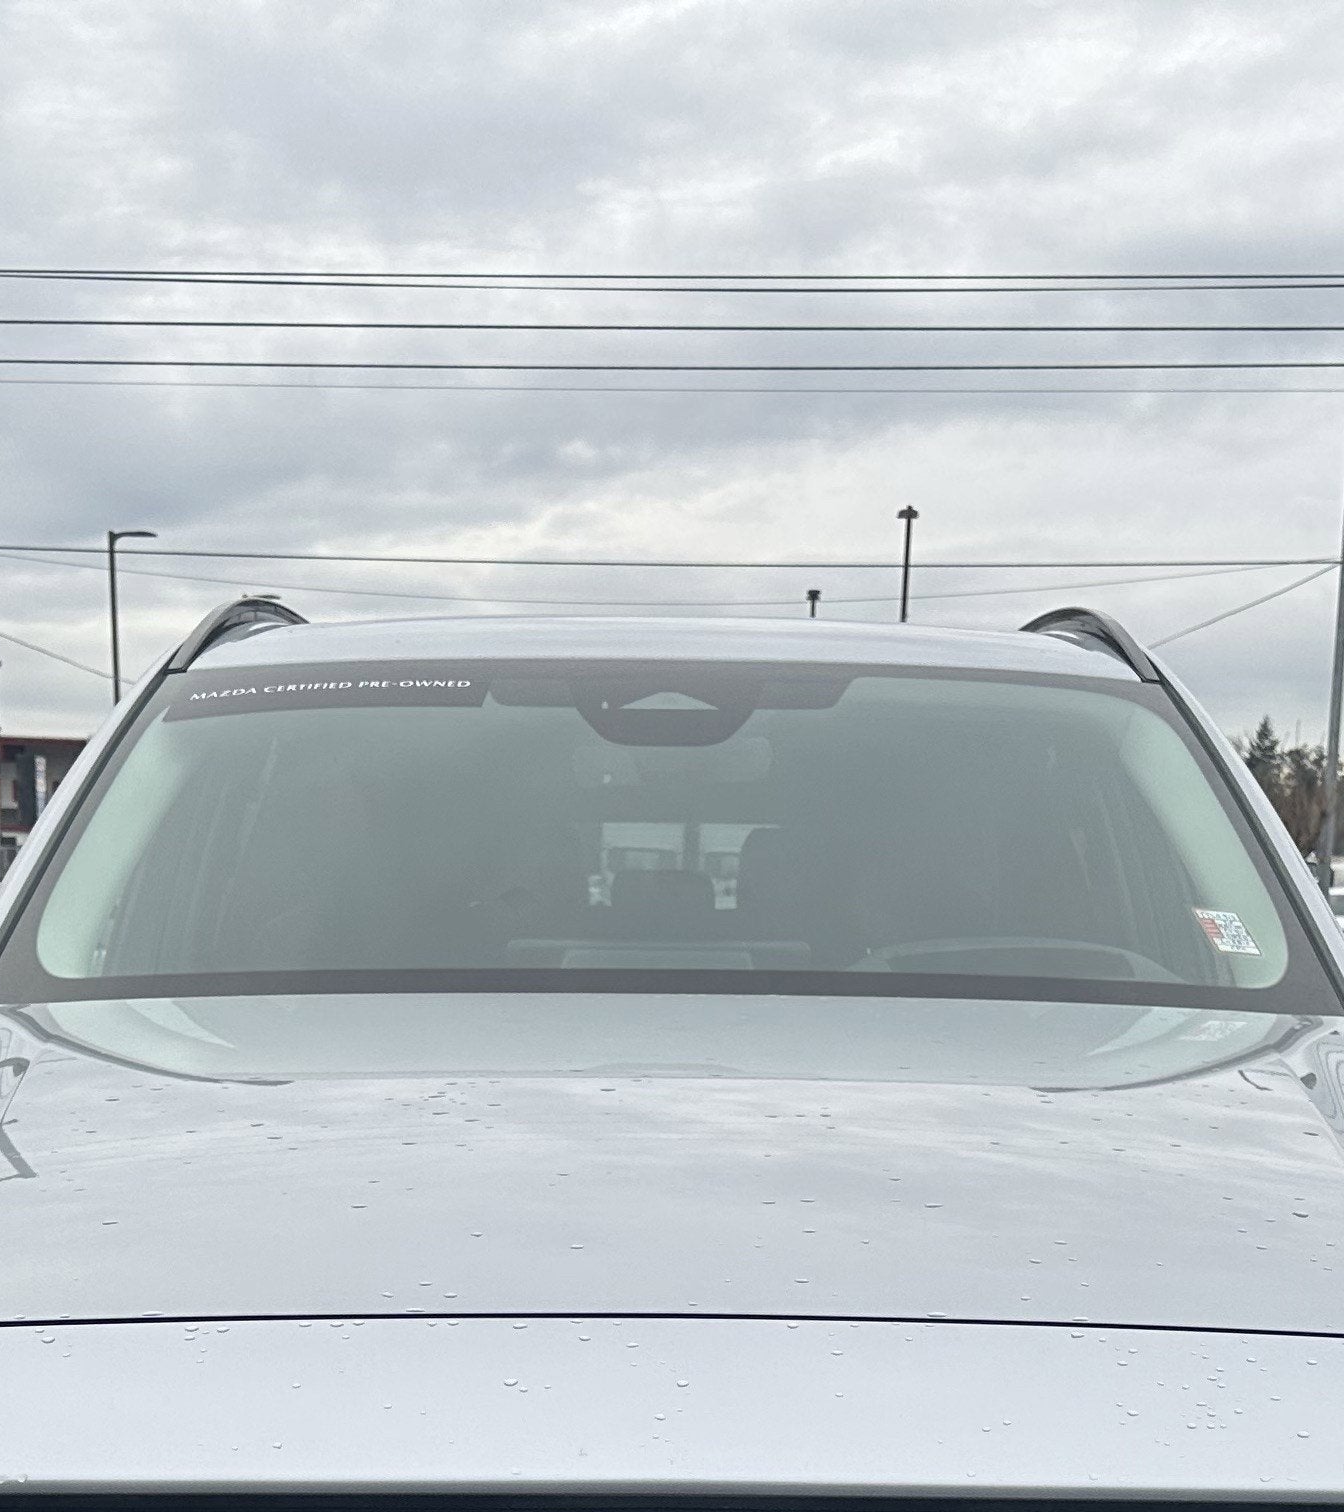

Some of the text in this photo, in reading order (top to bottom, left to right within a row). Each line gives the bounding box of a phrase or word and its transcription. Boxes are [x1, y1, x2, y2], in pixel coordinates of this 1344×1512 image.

[190, 680, 472, 700] MAZDA CERTIFIED PRE-OWNED
